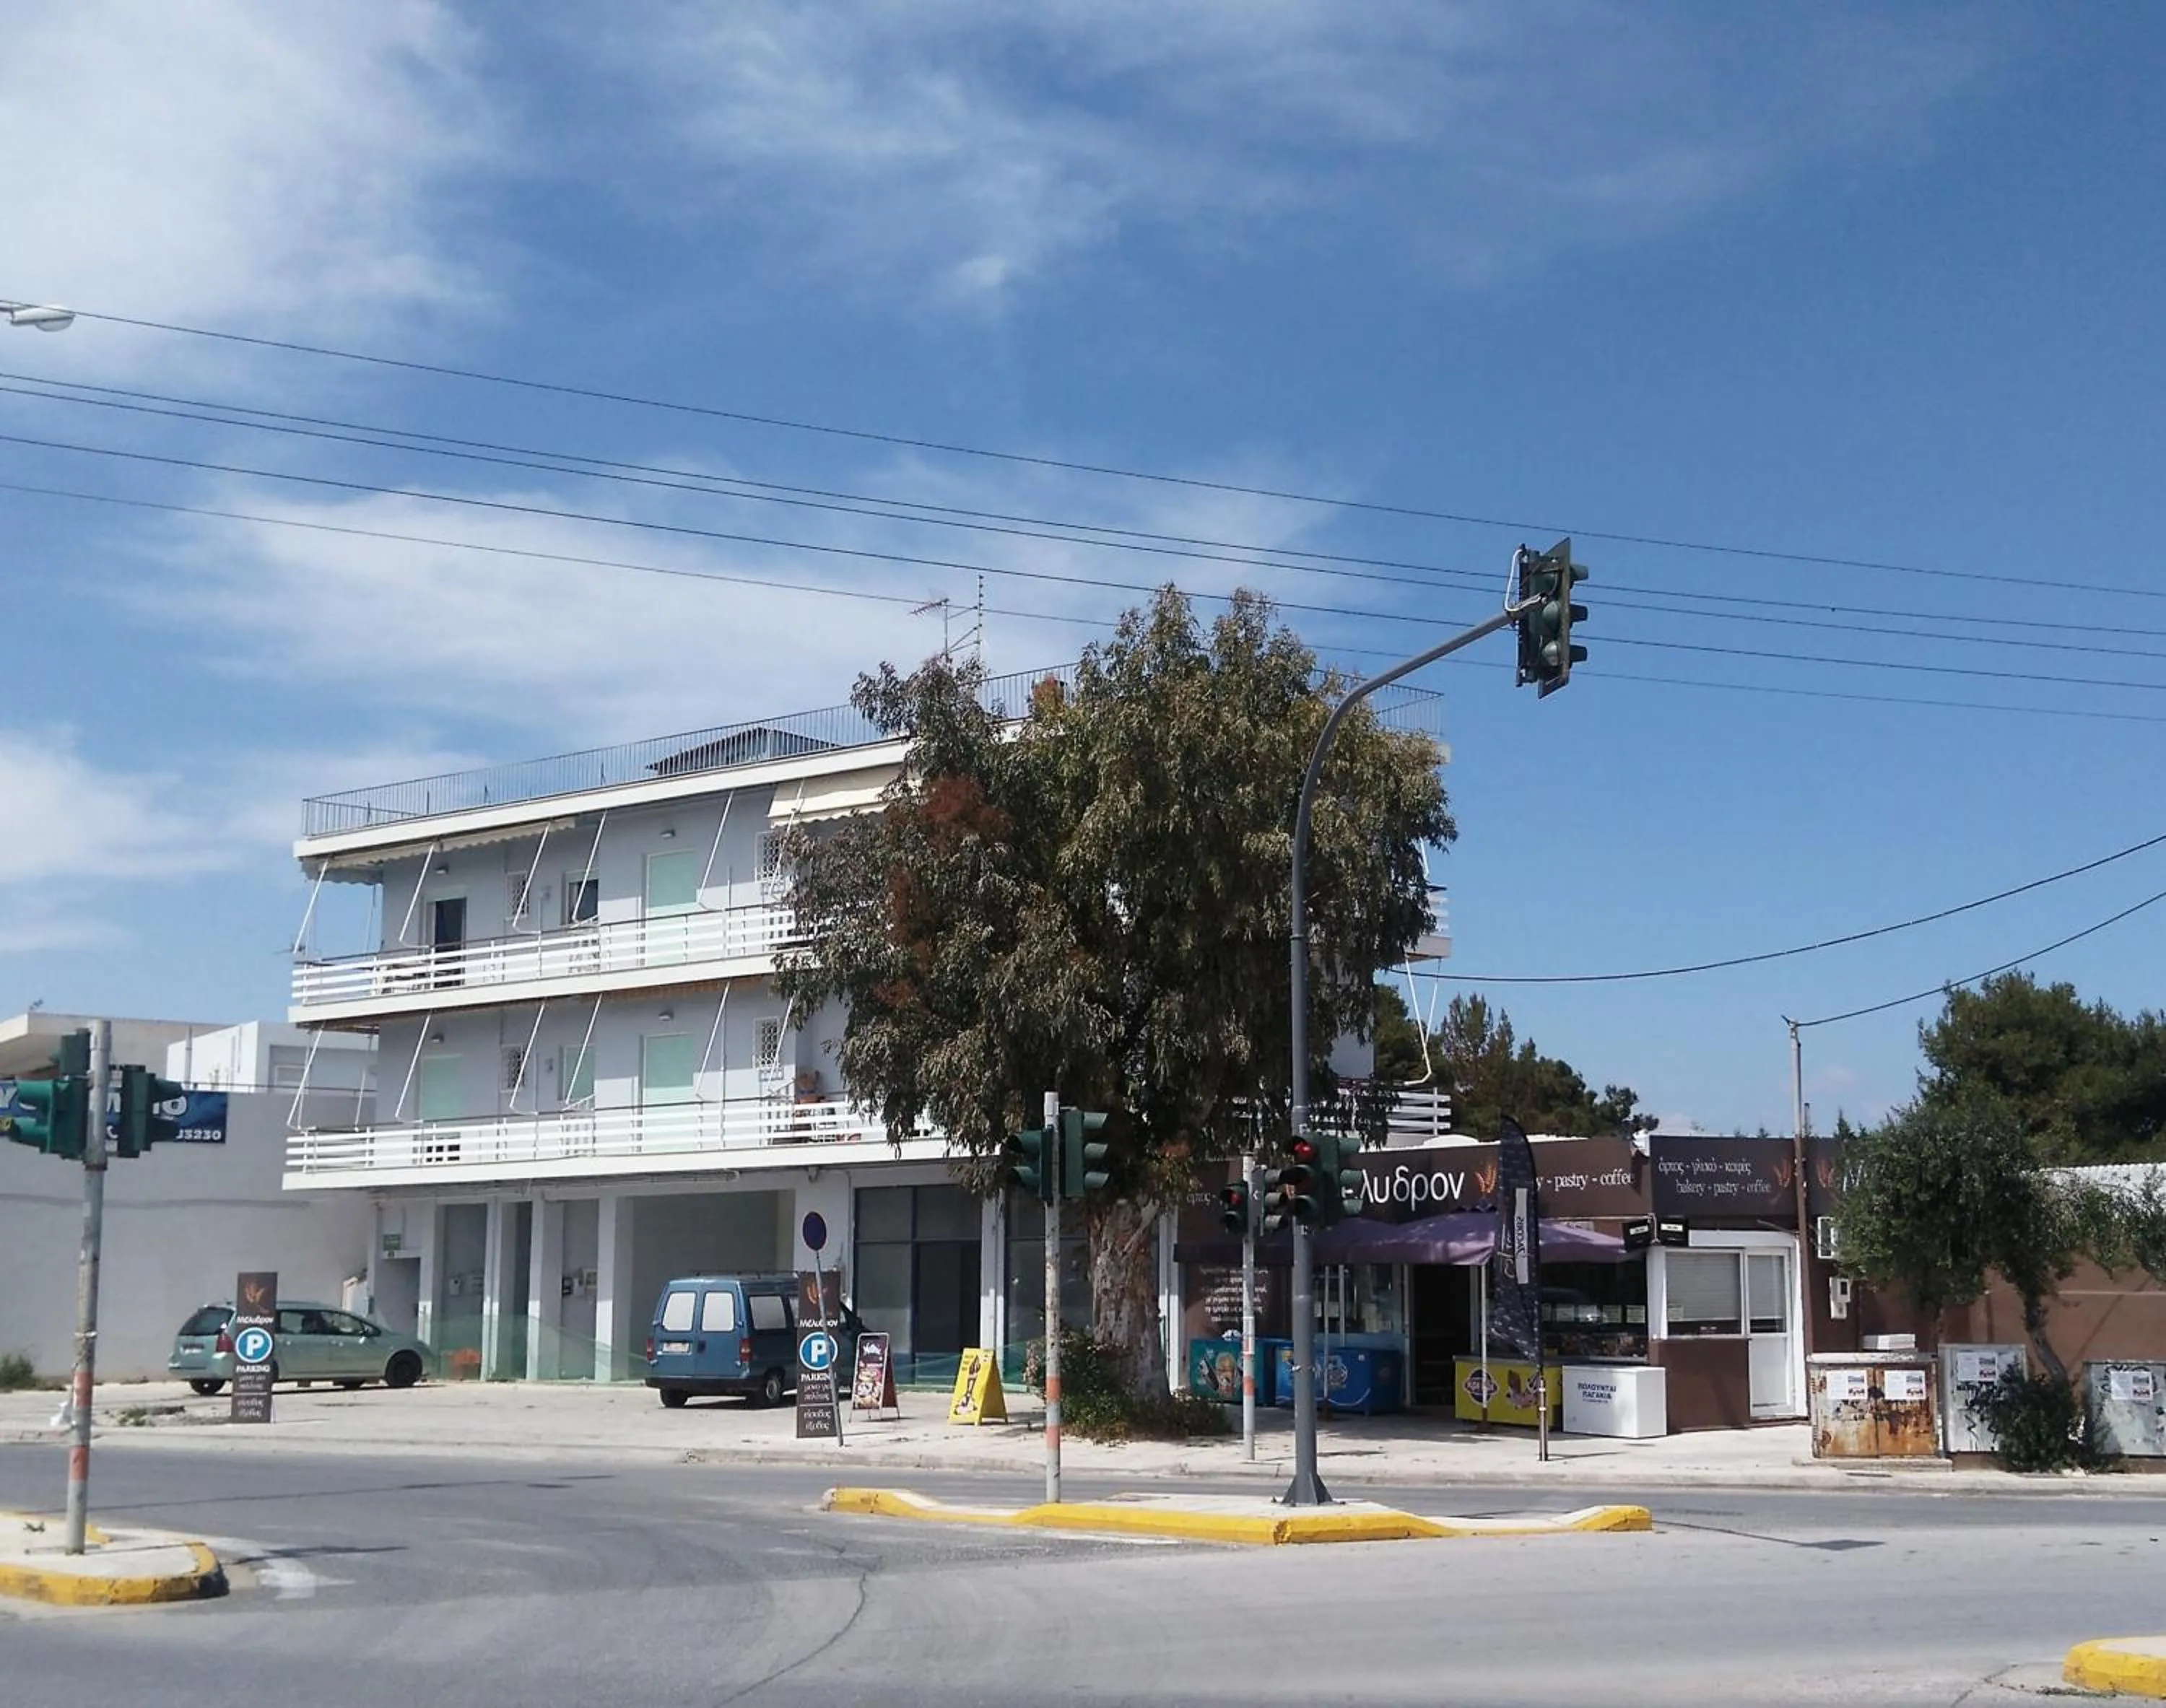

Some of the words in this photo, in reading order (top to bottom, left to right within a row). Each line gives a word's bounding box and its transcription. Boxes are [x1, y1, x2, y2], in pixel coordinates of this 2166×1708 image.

[1341, 1164, 1466, 1212] λυδρον
[1554, 1172, 1588, 1192] pastry
[246, 1334, 264, 1356] P
[811, 1339, 827, 1363] P
[235, 1364, 271, 1373] PARKING
